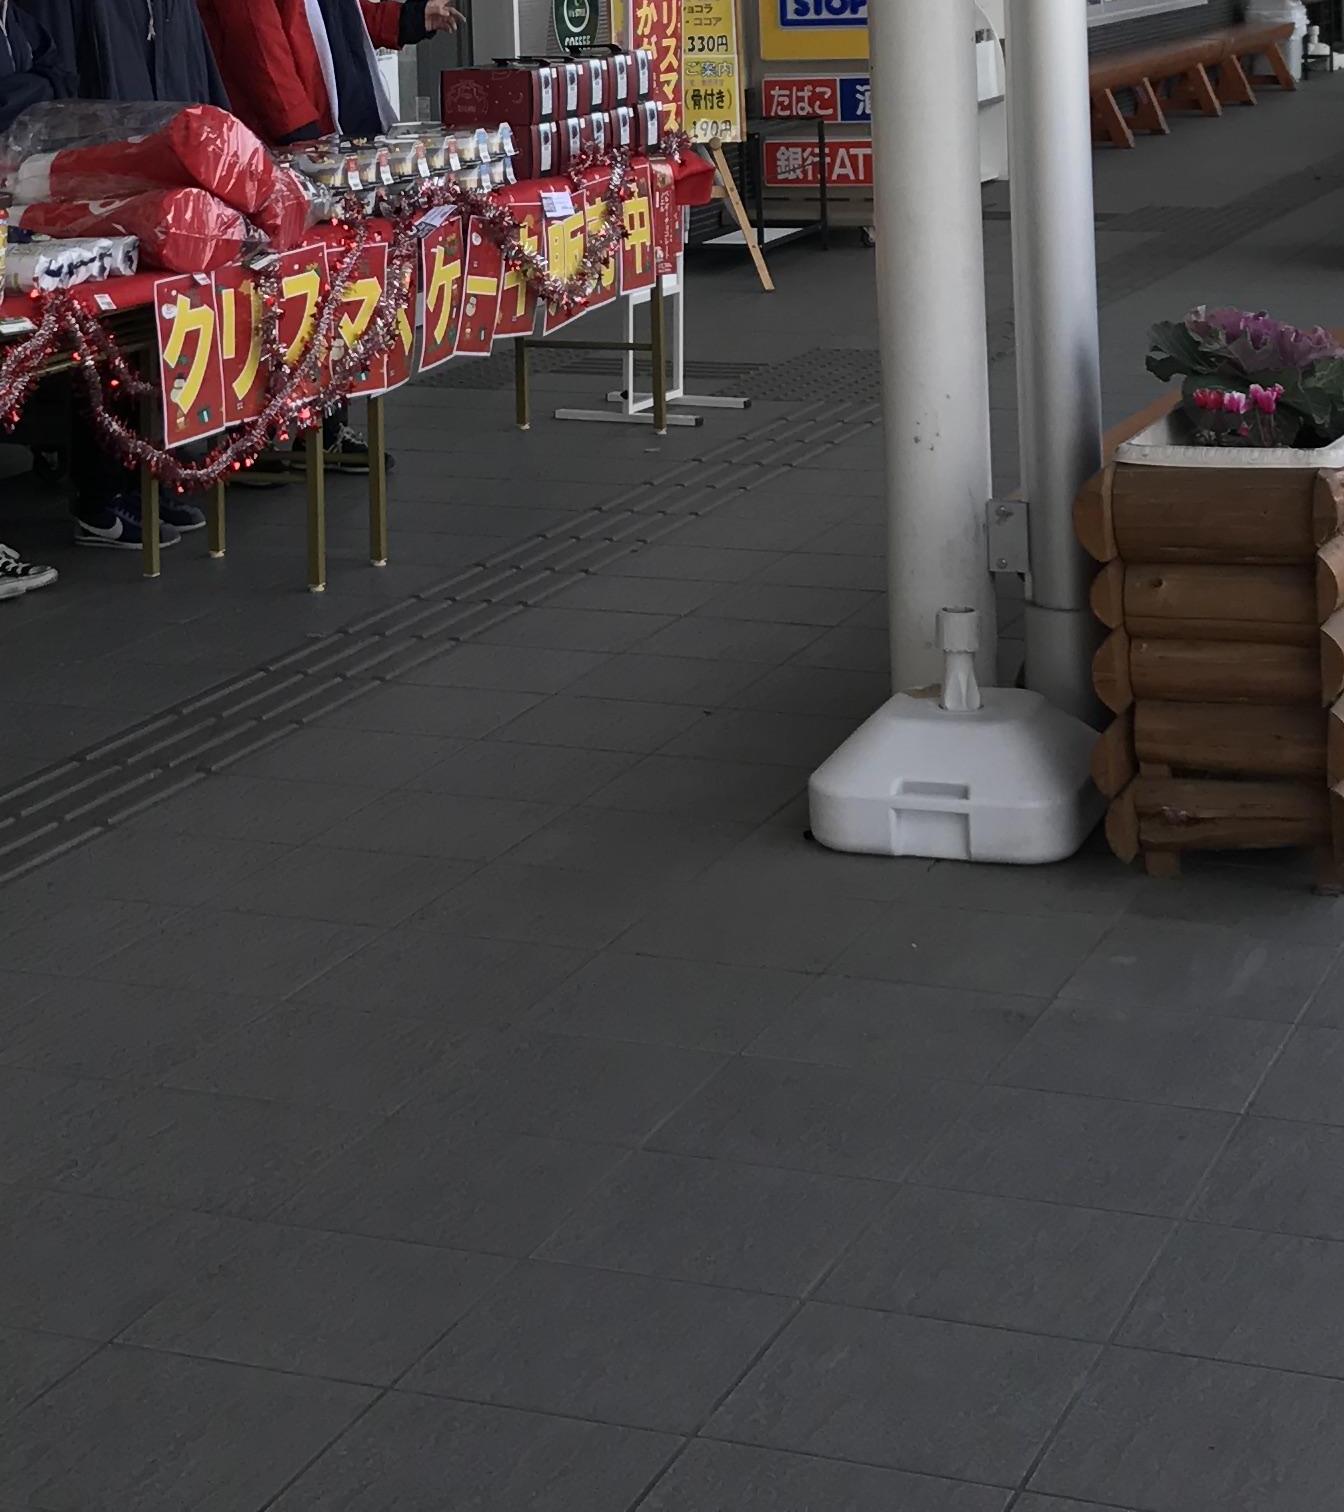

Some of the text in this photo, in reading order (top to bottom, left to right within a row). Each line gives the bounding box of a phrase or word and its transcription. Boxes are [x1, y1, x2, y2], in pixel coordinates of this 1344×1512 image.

[686, 61, 734, 78] ご案内
[770, 85, 834, 117] たばこ
[775, 146, 873, 181] 銀行AT
